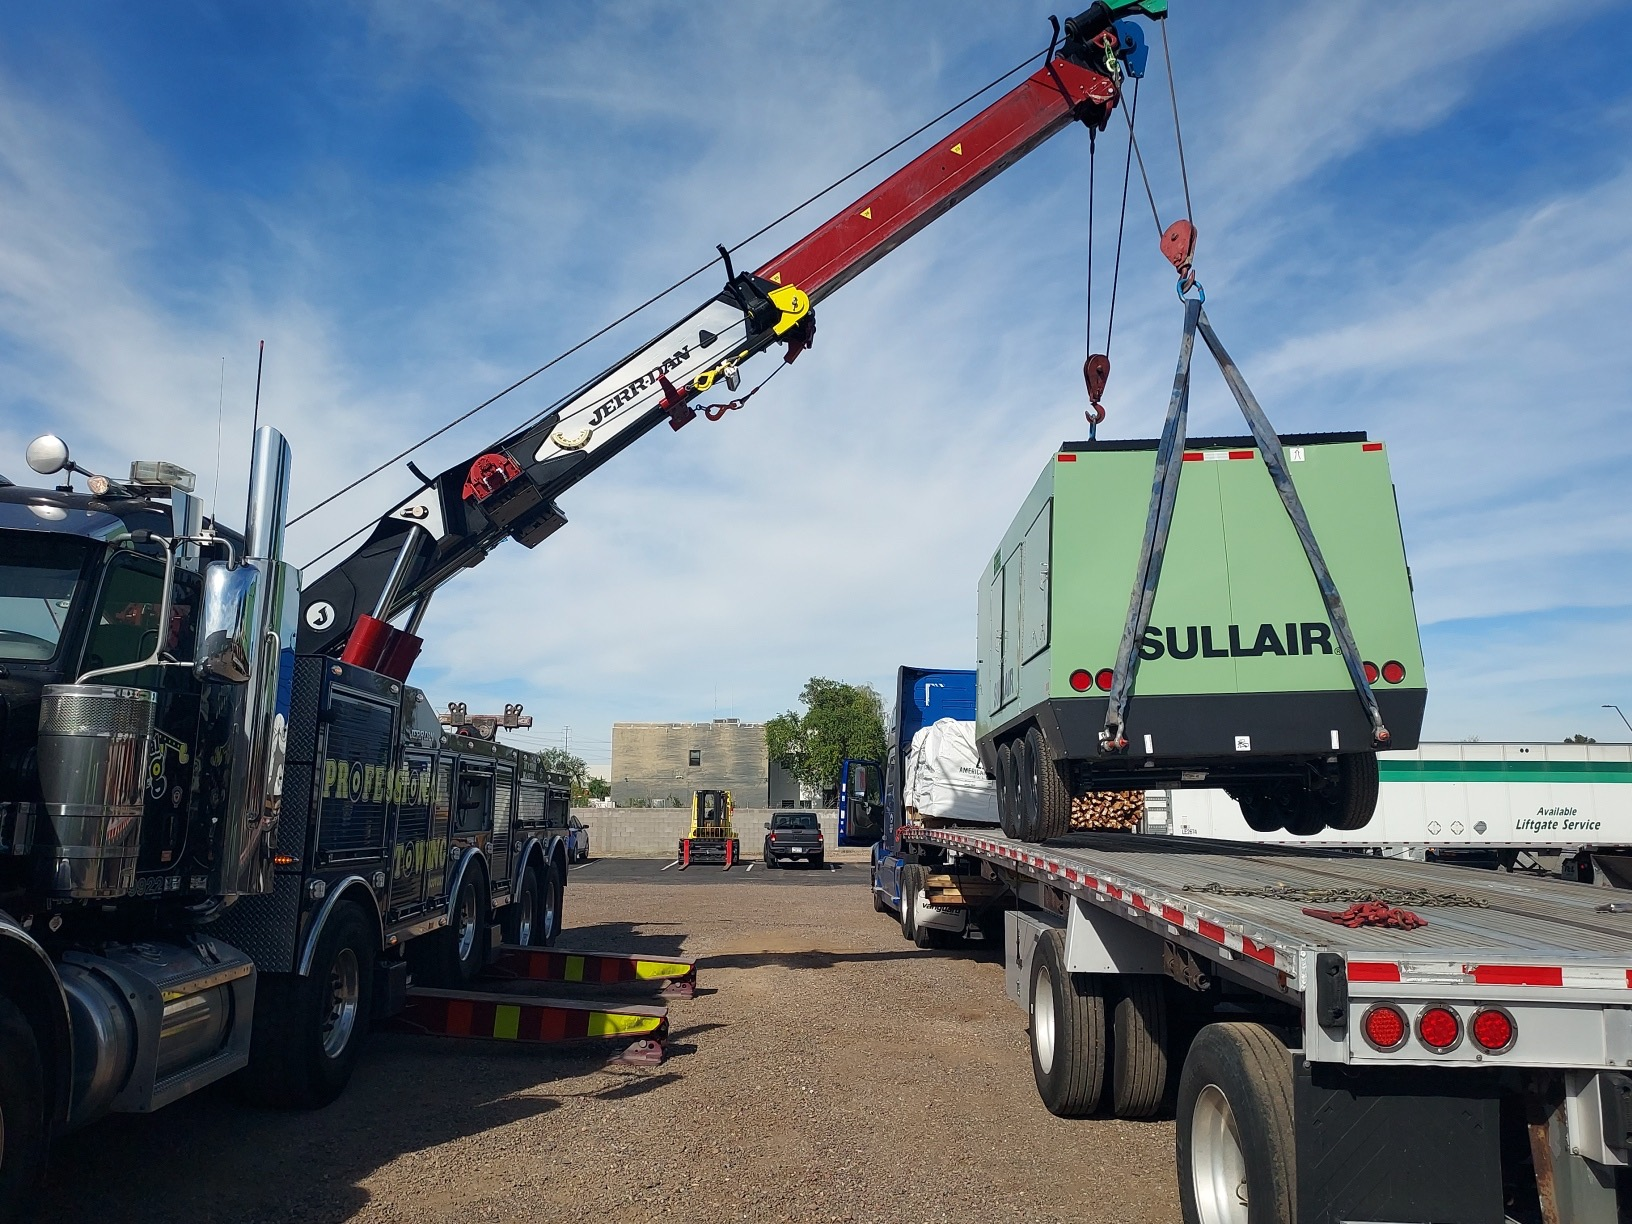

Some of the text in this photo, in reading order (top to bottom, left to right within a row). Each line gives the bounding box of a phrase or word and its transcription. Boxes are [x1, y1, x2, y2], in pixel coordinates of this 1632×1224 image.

[1138, 622, 1333, 661] SULLAIR
[1536, 806, 1578, 816] Available
[1515, 818, 1601, 833] Liftgate Service
